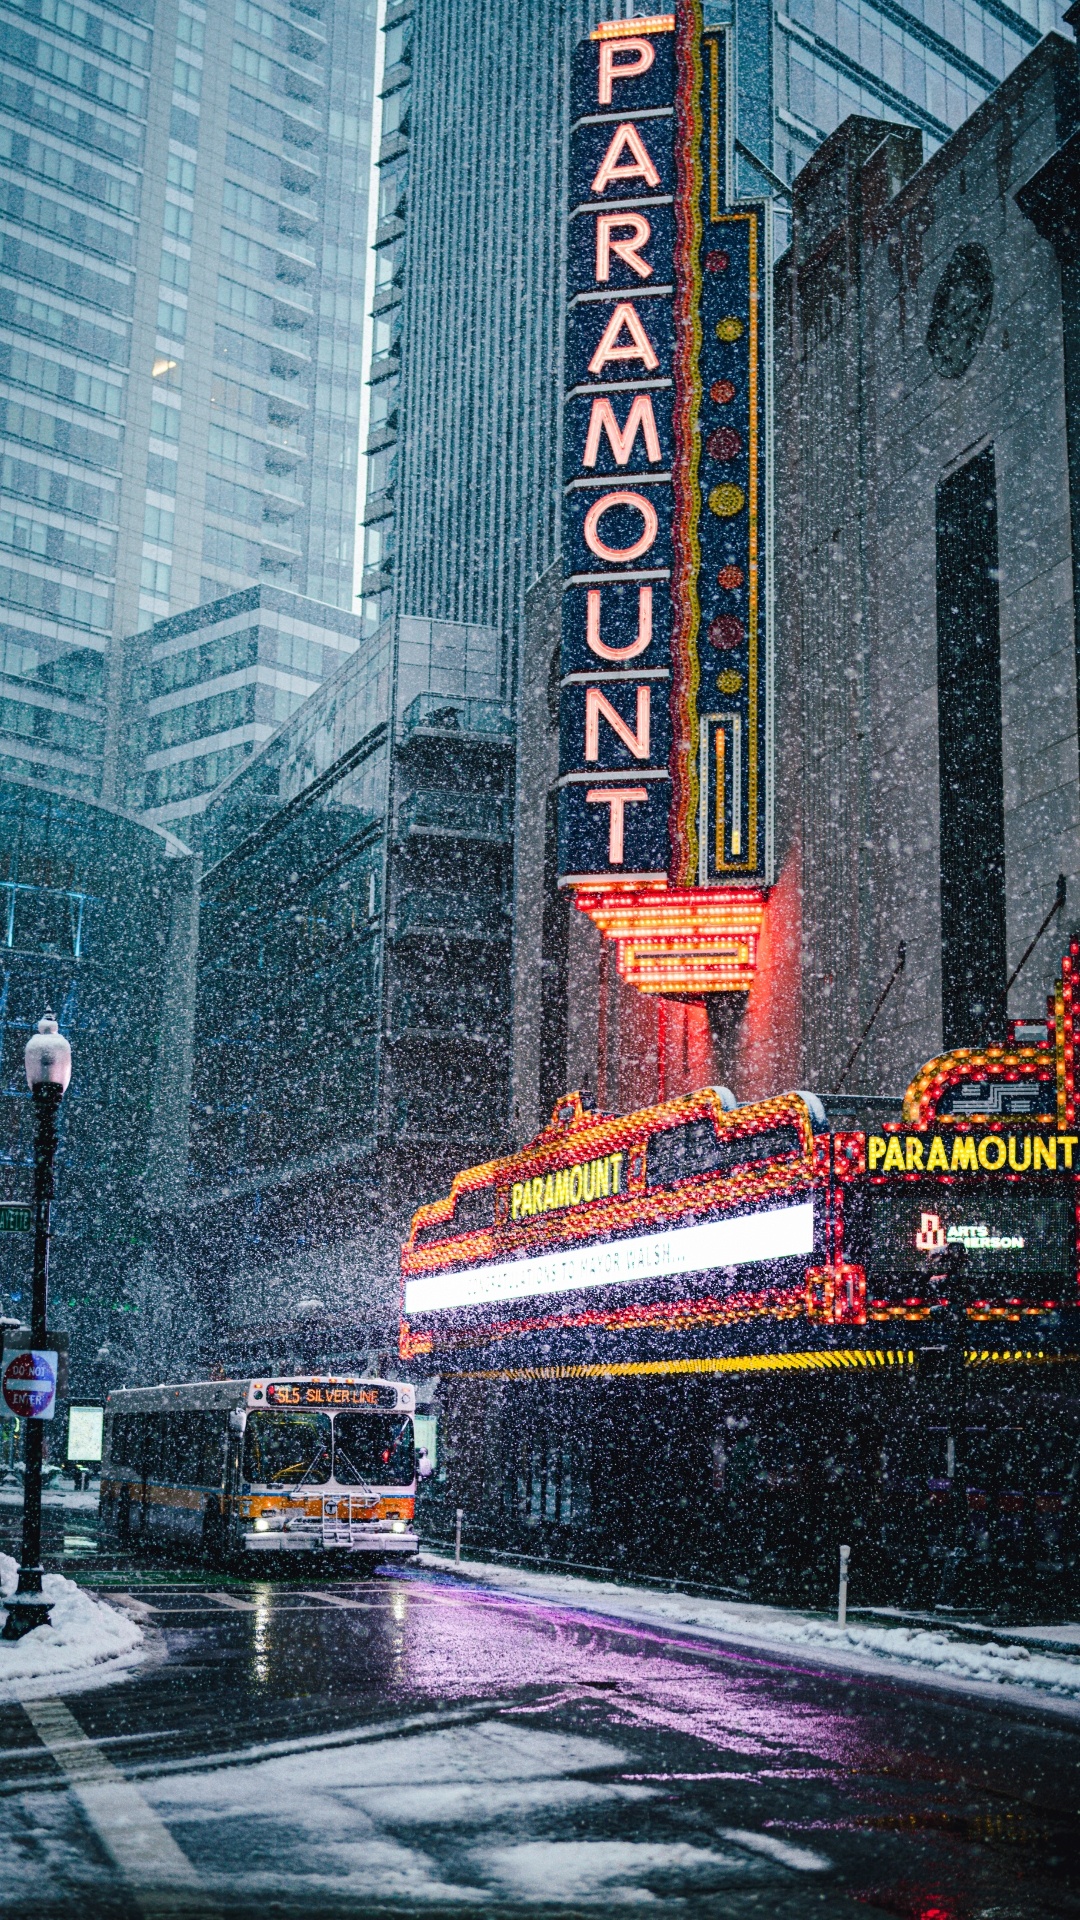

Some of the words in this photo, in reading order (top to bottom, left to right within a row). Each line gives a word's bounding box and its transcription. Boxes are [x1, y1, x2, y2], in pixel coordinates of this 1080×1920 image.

[582, 37, 662, 865] PARAMOUNT
[868, 1135, 1079, 1171] PARAMOUNT
[511, 1152, 622, 1220] PARAMOUNT
[946, 1225, 989, 1238] ARTS
[561, 1260, 576, 1281] TO
[579, 1252, 620, 1279] MAYOR
[12, 1365, 25, 1376] DO
[28, 1366, 46, 1377] NOT
[12, 1393, 43, 1405] ENTER
[277, 1387, 300, 1404] SL5
[306, 1388, 350, 1403] SILVER
[352, 1390, 379, 1405] LINE
